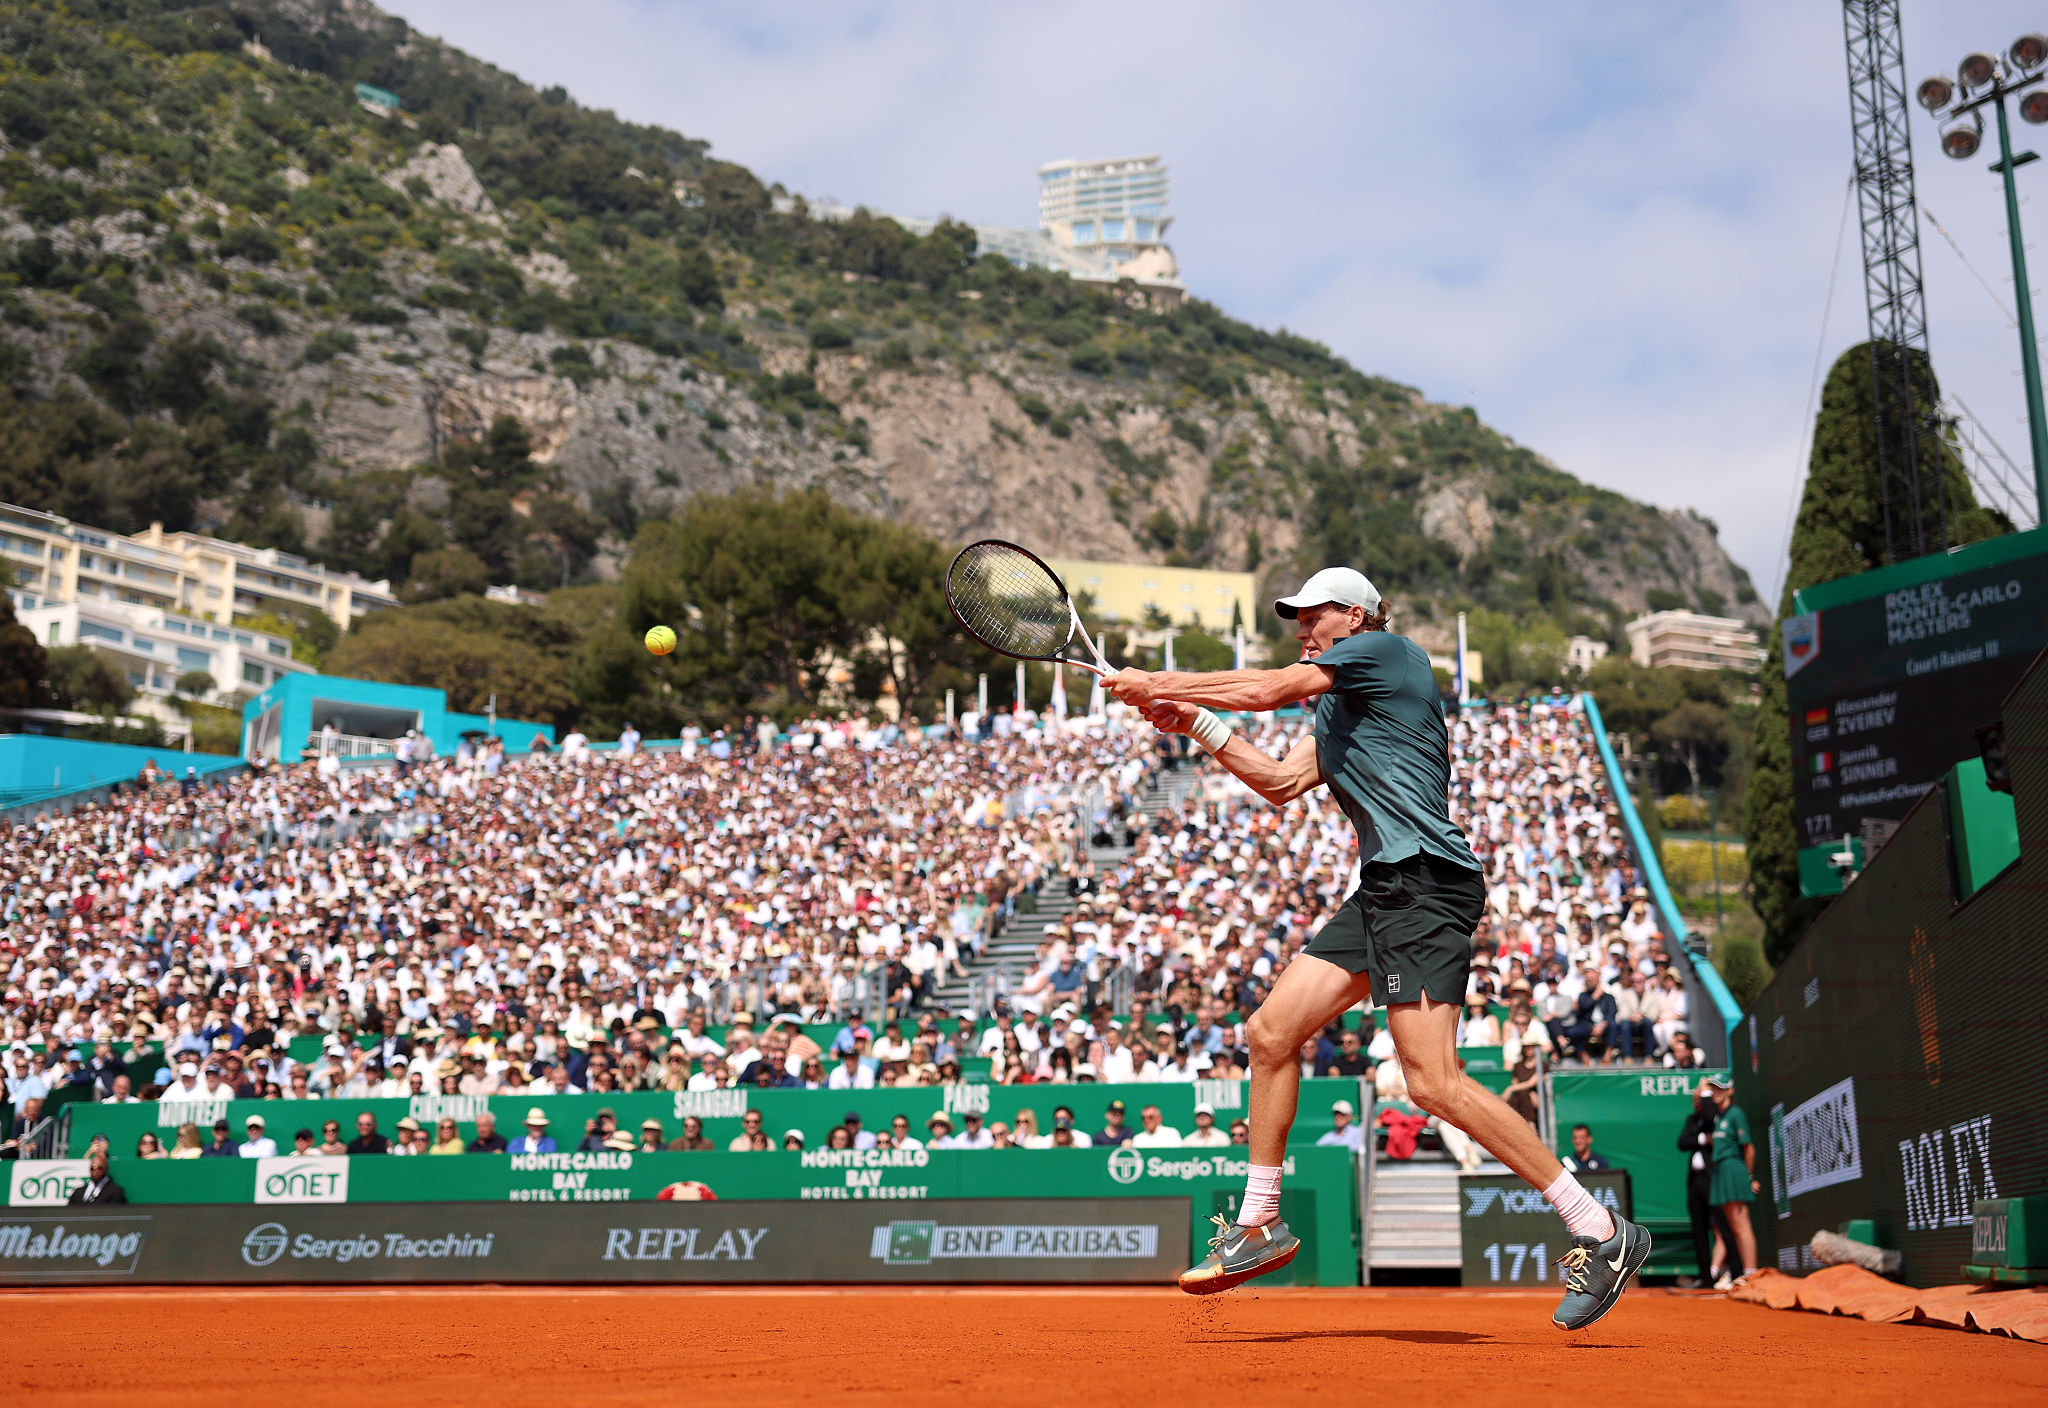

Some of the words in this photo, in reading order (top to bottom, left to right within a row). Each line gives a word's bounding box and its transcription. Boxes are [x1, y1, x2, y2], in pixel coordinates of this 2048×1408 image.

[1885, 580, 1944, 609] ROLEX
[1887, 580, 2022, 625] MONTE-CARLO
[1887, 610, 1971, 646] MASTERS
[1906, 654, 1938, 676] Court
[1939, 646, 1984, 669] Rainier
[1835, 690, 1898, 715] Alexander
[1806, 725, 1830, 742] GER
[1836, 706, 1897, 735] ZVEREV
[1838, 744, 1879, 766] Jannik
[1812, 774, 1832, 790] ITA
[1840, 757, 1898, 785] SINNER
[1805, 813, 1832, 835] 171
[409, 1095, 490, 1123] CINCINNATI
[674, 1089, 748, 1119] SHANGHAI
[944, 1083, 990, 1114] PARIS
[1193, 1080, 1242, 1110] TURIN
[510, 1151, 633, 1170] MONTE-CARLO
[801, 1149, 929, 1168] MONTE-CARLO
[1147, 1156, 1212, 1181] Sergio
[1898, 1113, 1999, 1231] ROLEX
[266, 1172, 342, 1196] ONET
[552, 1172, 589, 1189] BAY
[845, 1169, 884, 1187] BAY
[509, 1189, 553, 1201] HOTEL
[559, 1189, 570, 1201] &
[573, 1188, 631, 1201] RESORT
[801, 1187, 849, 1199] HOTEL
[853, 1187, 864, 1199] &
[868, 1186, 928, 1199] RESORT
[0, 1225, 142, 1267] Malongo
[601, 1228, 770, 1261] REPLAY
[942, 1230, 1004, 1253] BNP
[1014, 1229, 1141, 1253] PARIBAS
[1973, 1214, 2009, 1252] REPLAY
[291, 1233, 381, 1263] Sergio
[384, 1232, 495, 1258] Tacchini
[1483, 1242, 1548, 1282] 171
